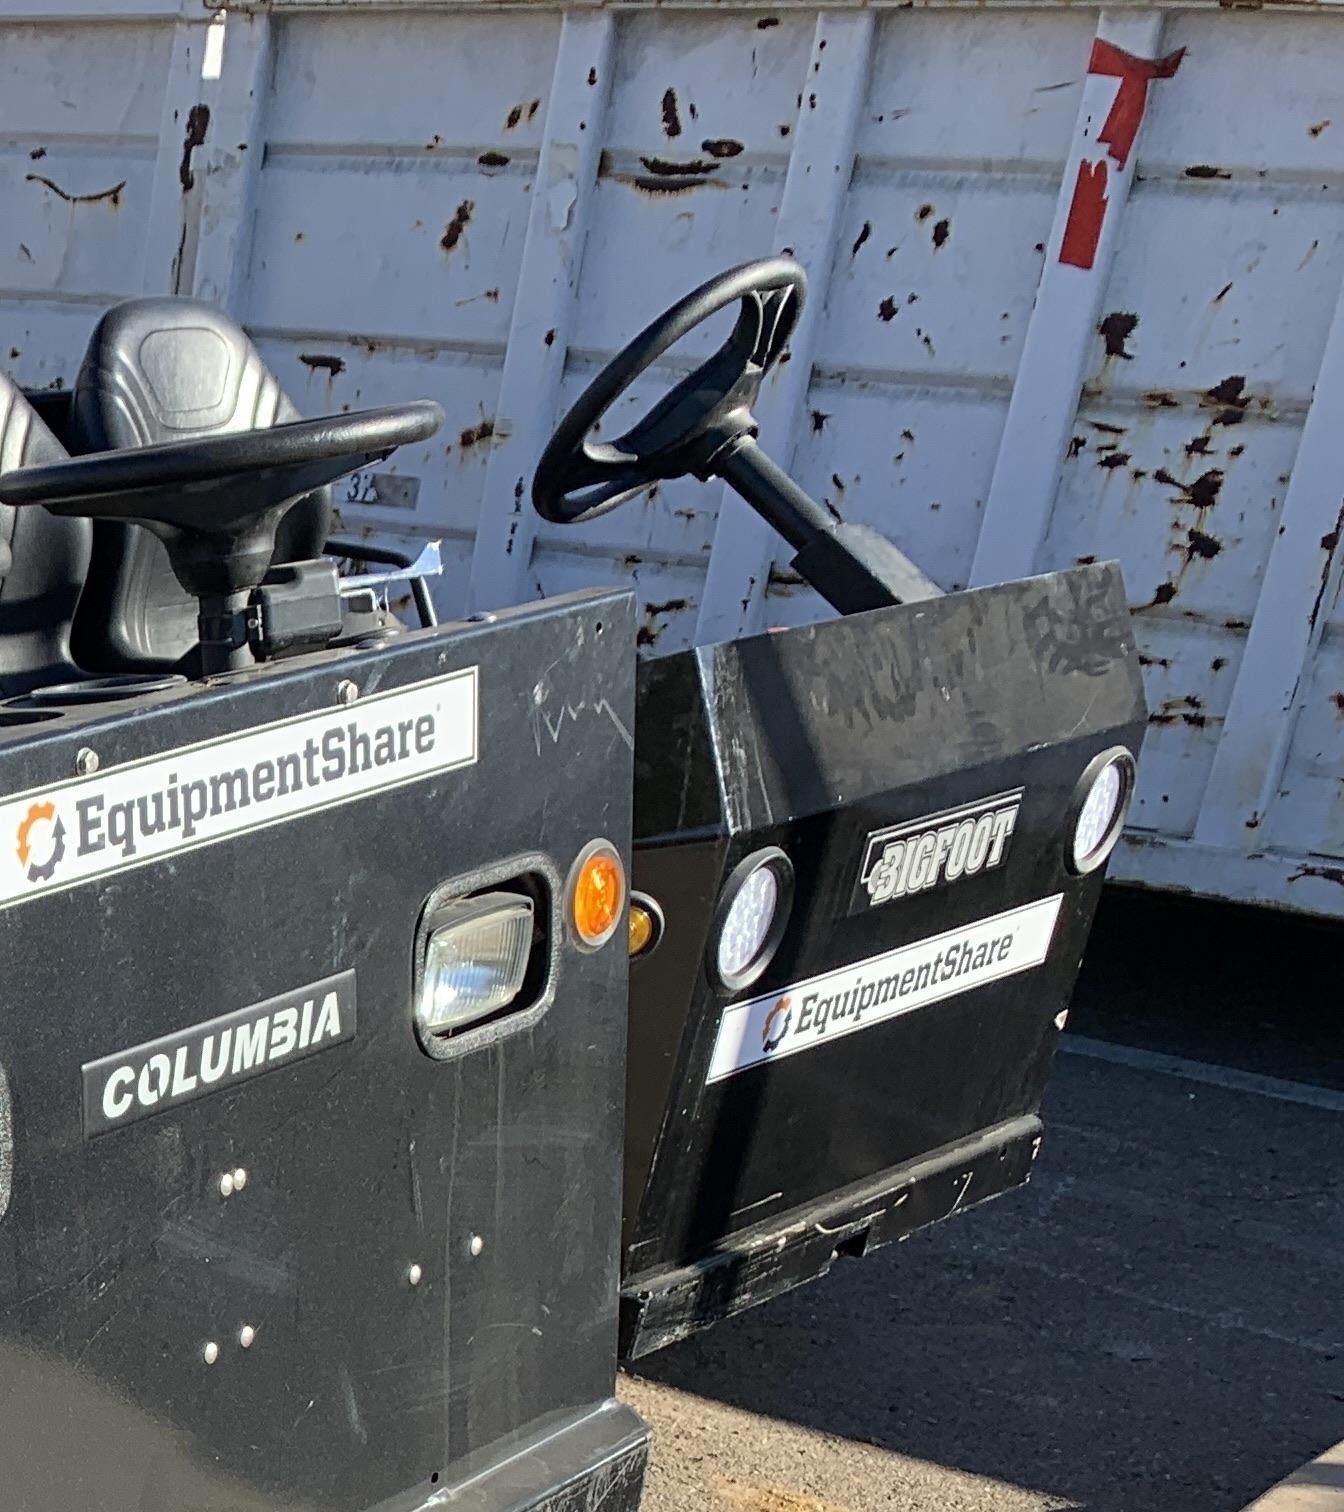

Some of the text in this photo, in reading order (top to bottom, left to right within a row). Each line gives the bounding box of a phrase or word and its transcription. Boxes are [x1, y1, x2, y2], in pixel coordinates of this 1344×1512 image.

[75, 711, 436, 857] EquipmentShare
[867, 803, 1021, 907] BIGFOOT
[794, 930, 1013, 1036] EquipmentShare
[101, 990, 343, 1120] COLUMBIA
